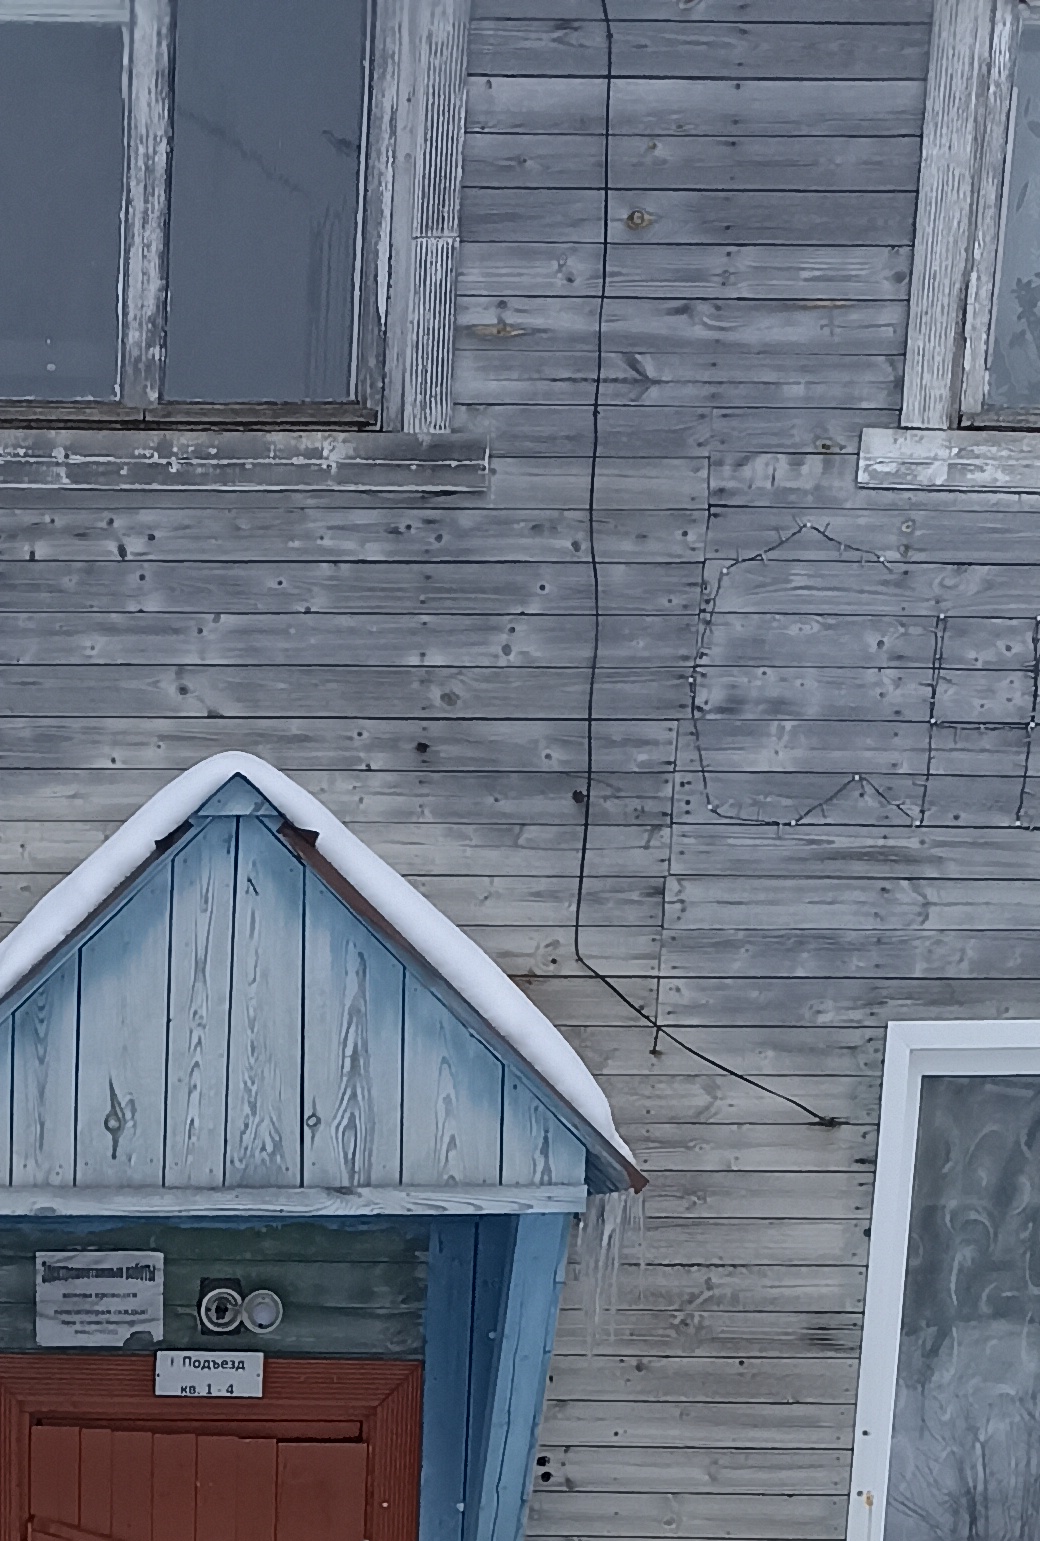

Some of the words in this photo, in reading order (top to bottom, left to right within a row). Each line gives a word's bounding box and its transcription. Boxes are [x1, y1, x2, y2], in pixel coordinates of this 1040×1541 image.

[182, 1355, 246, 1371] Подъезд
[180, 1385, 201, 1395] кв.
[205, 1383, 213, 1395] 1
[225, 1384, 235, 1395] 4
